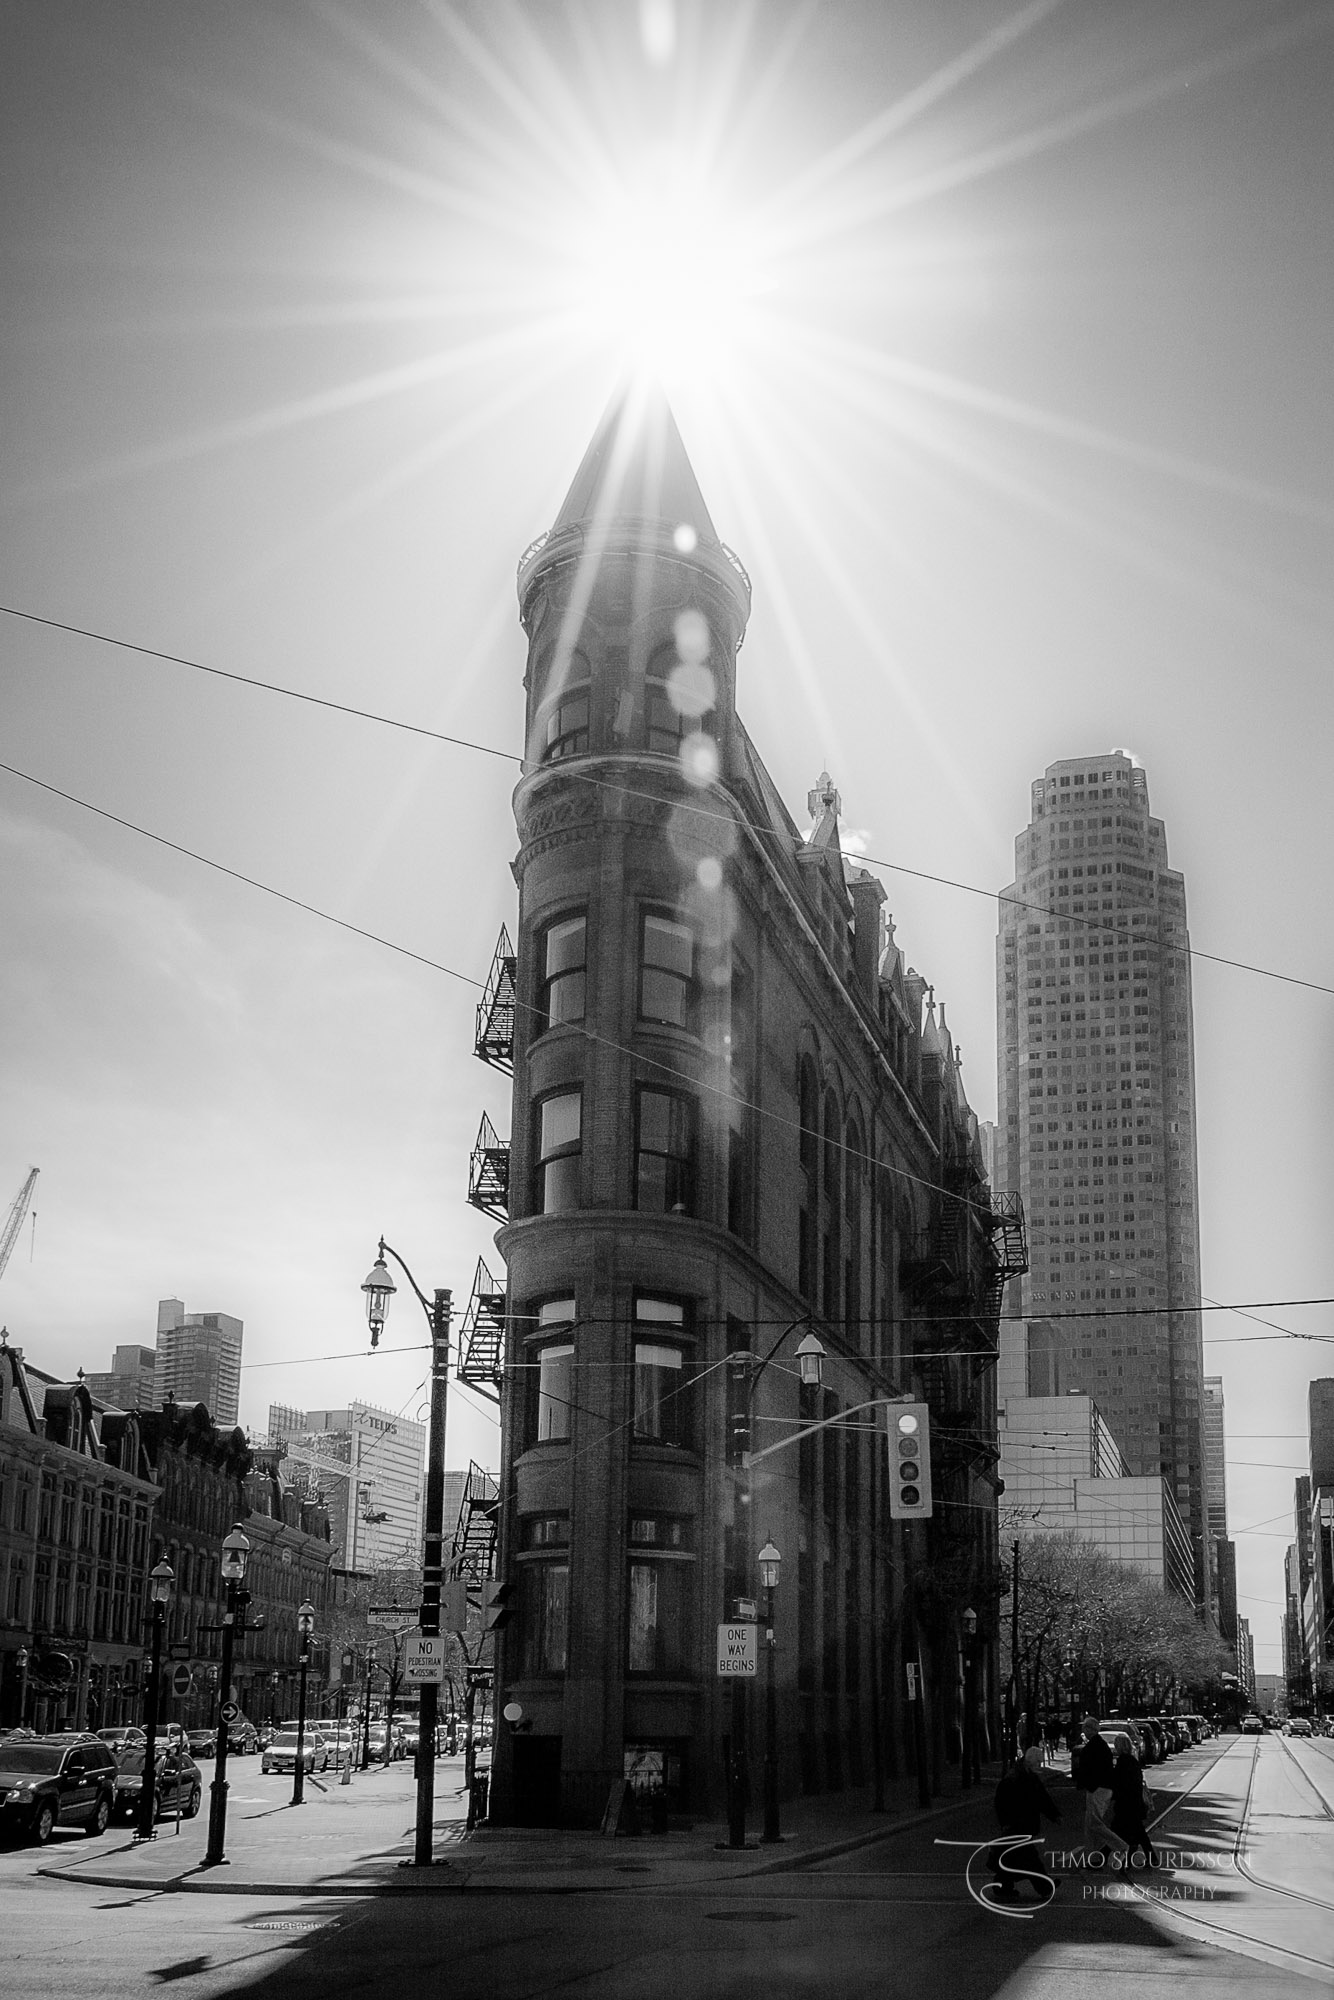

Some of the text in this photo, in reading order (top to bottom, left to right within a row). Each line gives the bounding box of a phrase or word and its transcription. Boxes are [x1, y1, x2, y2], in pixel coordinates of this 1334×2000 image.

[369, 1416, 398, 1435] TELUS
[375, 1616, 399, 1624] CHURCH
[727, 1629, 747, 1641] ONE
[418, 1641, 433, 1655] NO
[727, 1644, 747, 1656] WAY
[408, 1657, 441, 1666] PEDESTRIAN
[719, 1659, 755, 1672] BEGINS
